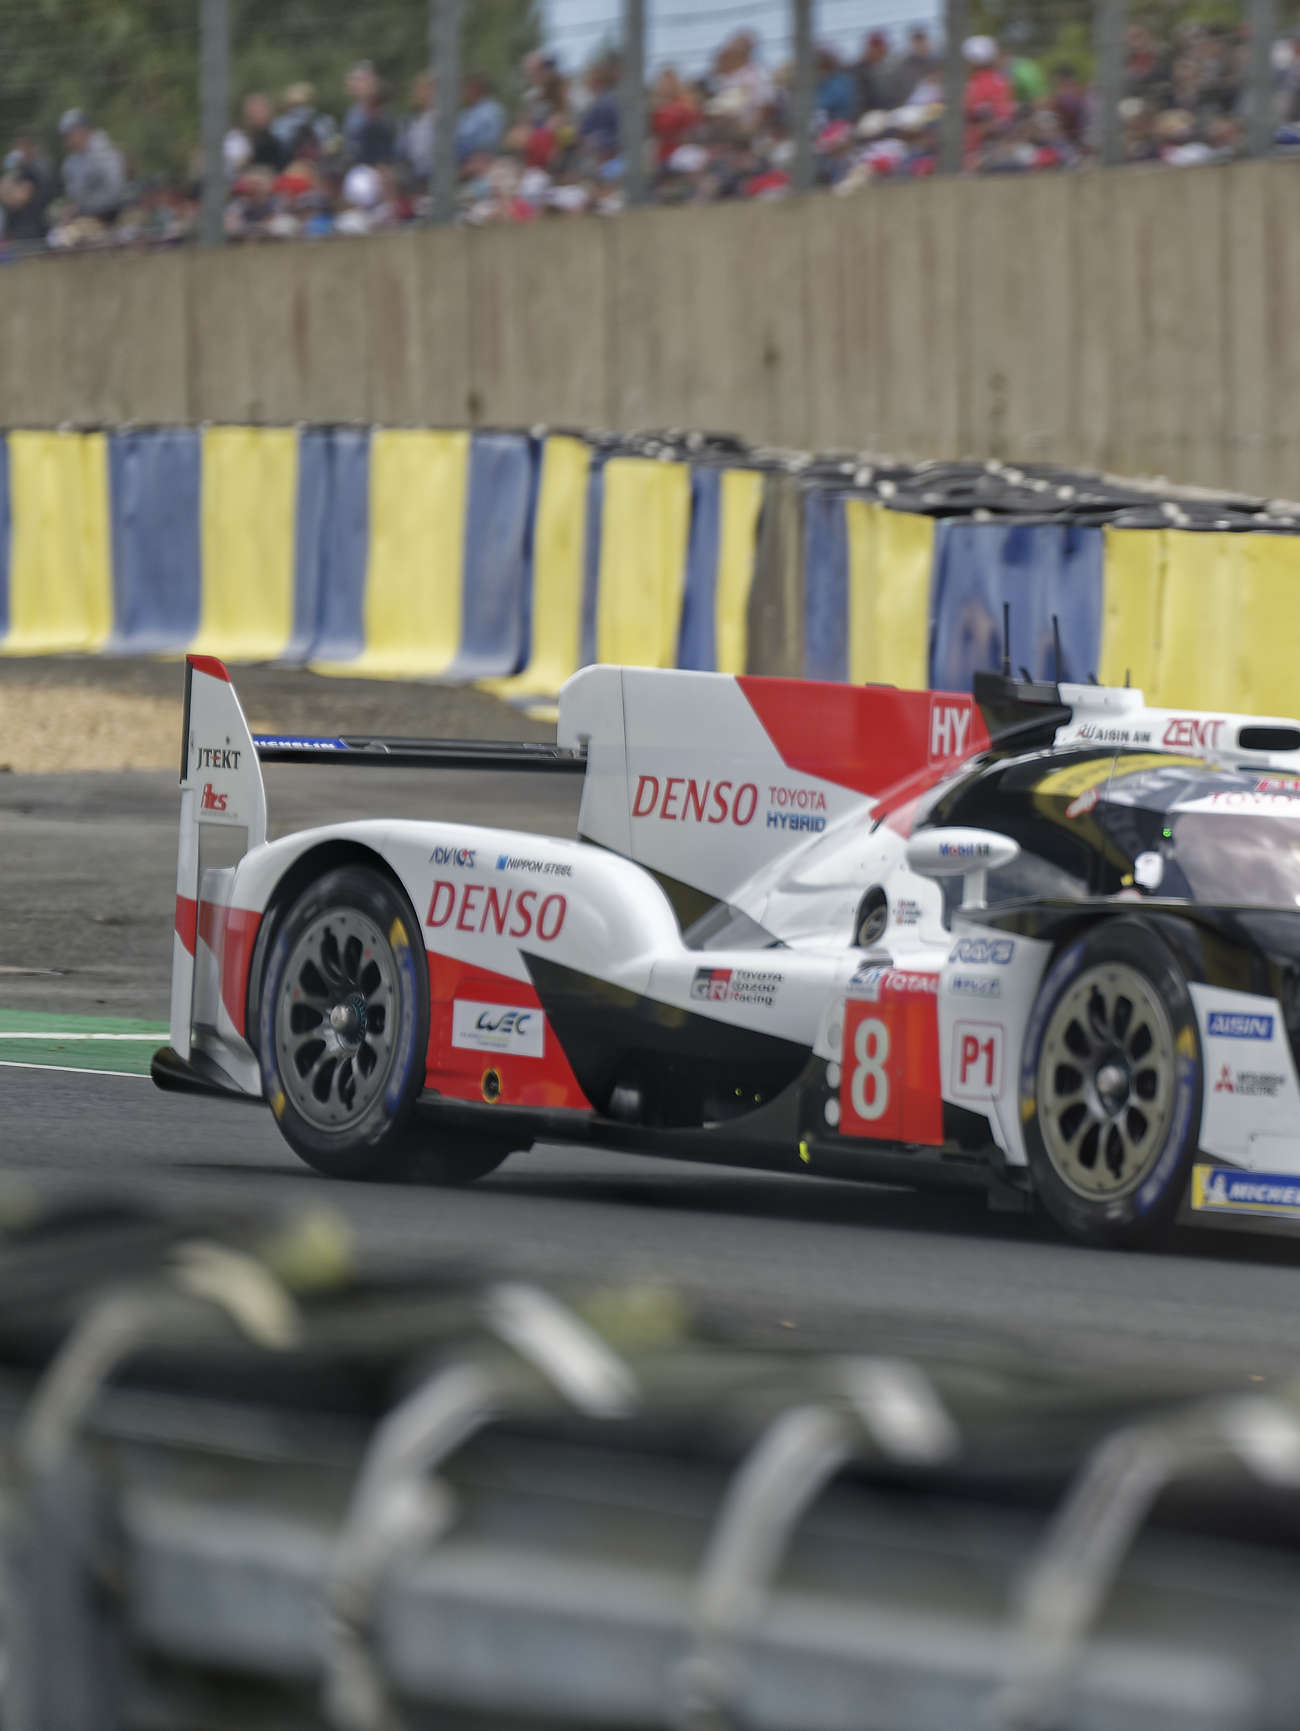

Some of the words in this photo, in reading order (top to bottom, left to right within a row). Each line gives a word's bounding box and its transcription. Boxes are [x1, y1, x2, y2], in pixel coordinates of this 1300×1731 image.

[931, 706, 970, 756] HY
[1162, 718, 1226, 748] ZENT
[197, 749, 241, 770] JTEKT
[632, 775, 758, 826] DENSO
[768, 786, 826, 809] TOYOTA
[766, 811, 826, 833] HYBRID
[507, 858, 541, 872] NIPPON
[542, 863, 573, 877] STEEL
[426, 880, 567, 942] DENSO
[885, 969, 938, 995] TOTAL
[475, 1011, 532, 1034] WEC
[1212, 1014, 1269, 1037] AISIN
[851, 1018, 891, 1120] 8
[960, 1035, 996, 1086] P1
